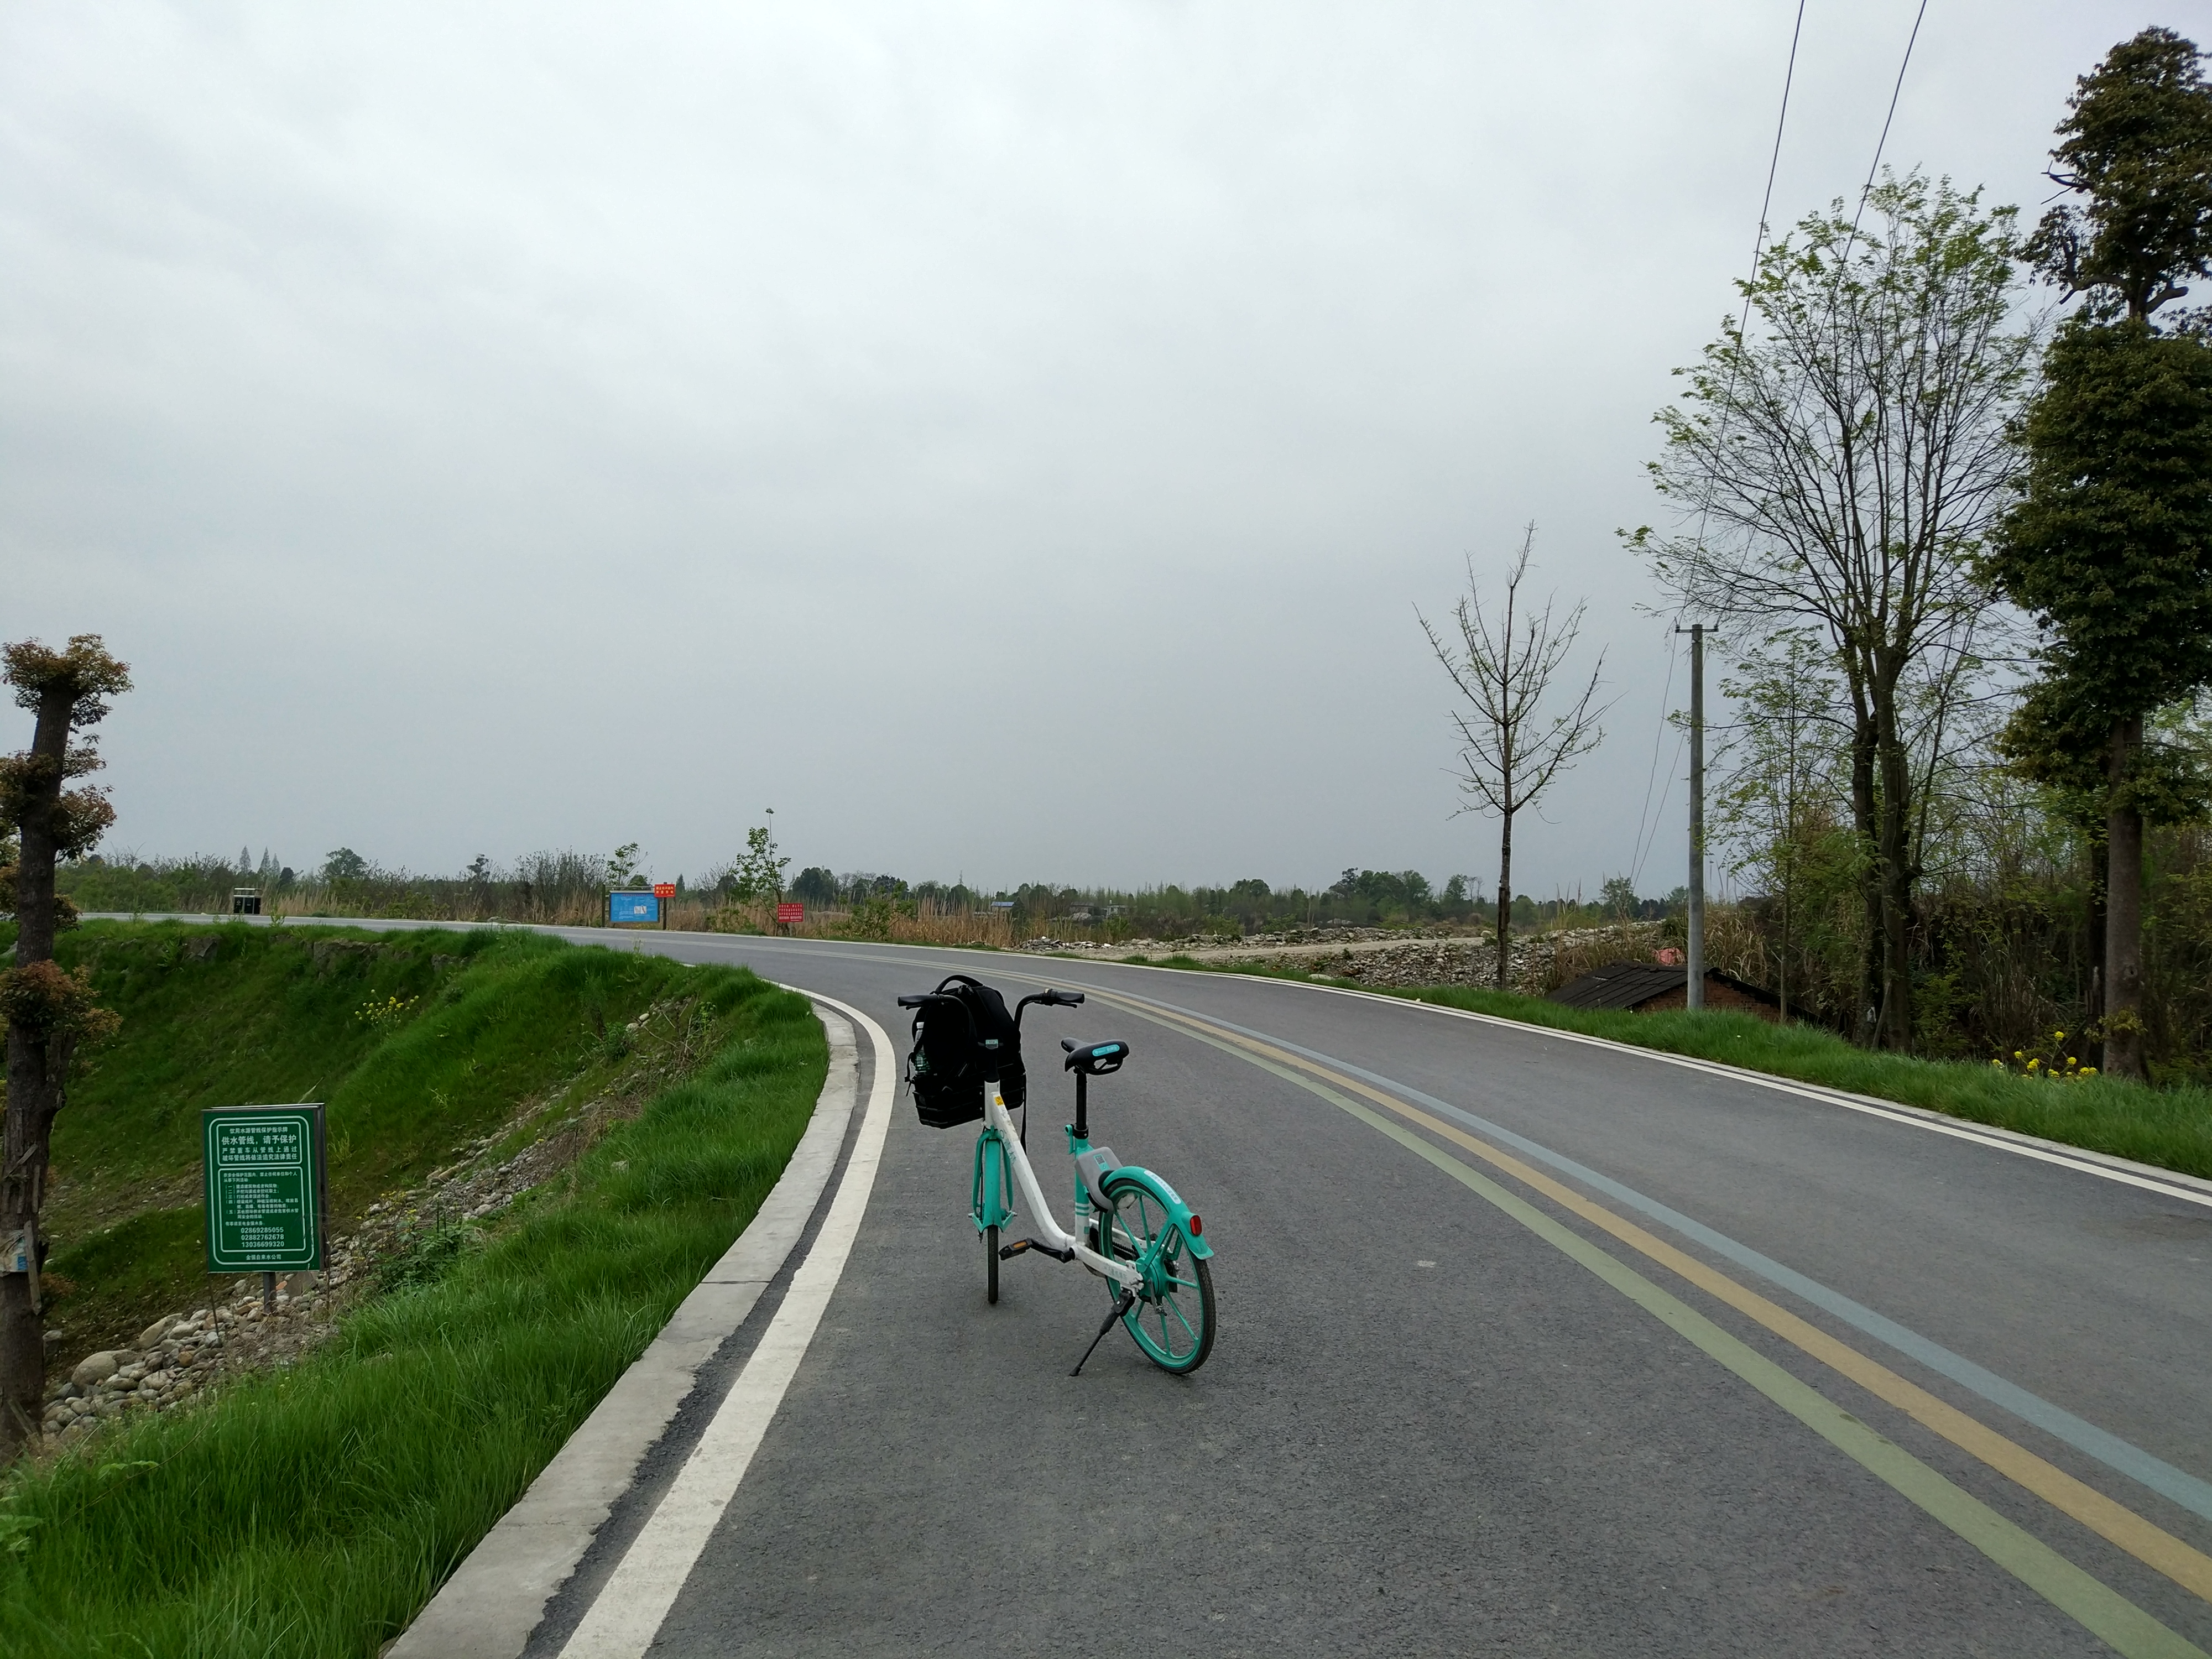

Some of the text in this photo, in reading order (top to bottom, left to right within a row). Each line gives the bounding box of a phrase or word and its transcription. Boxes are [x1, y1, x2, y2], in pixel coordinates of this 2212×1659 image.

[221, 1134, 297, 1145] 供水管线，请予保护
